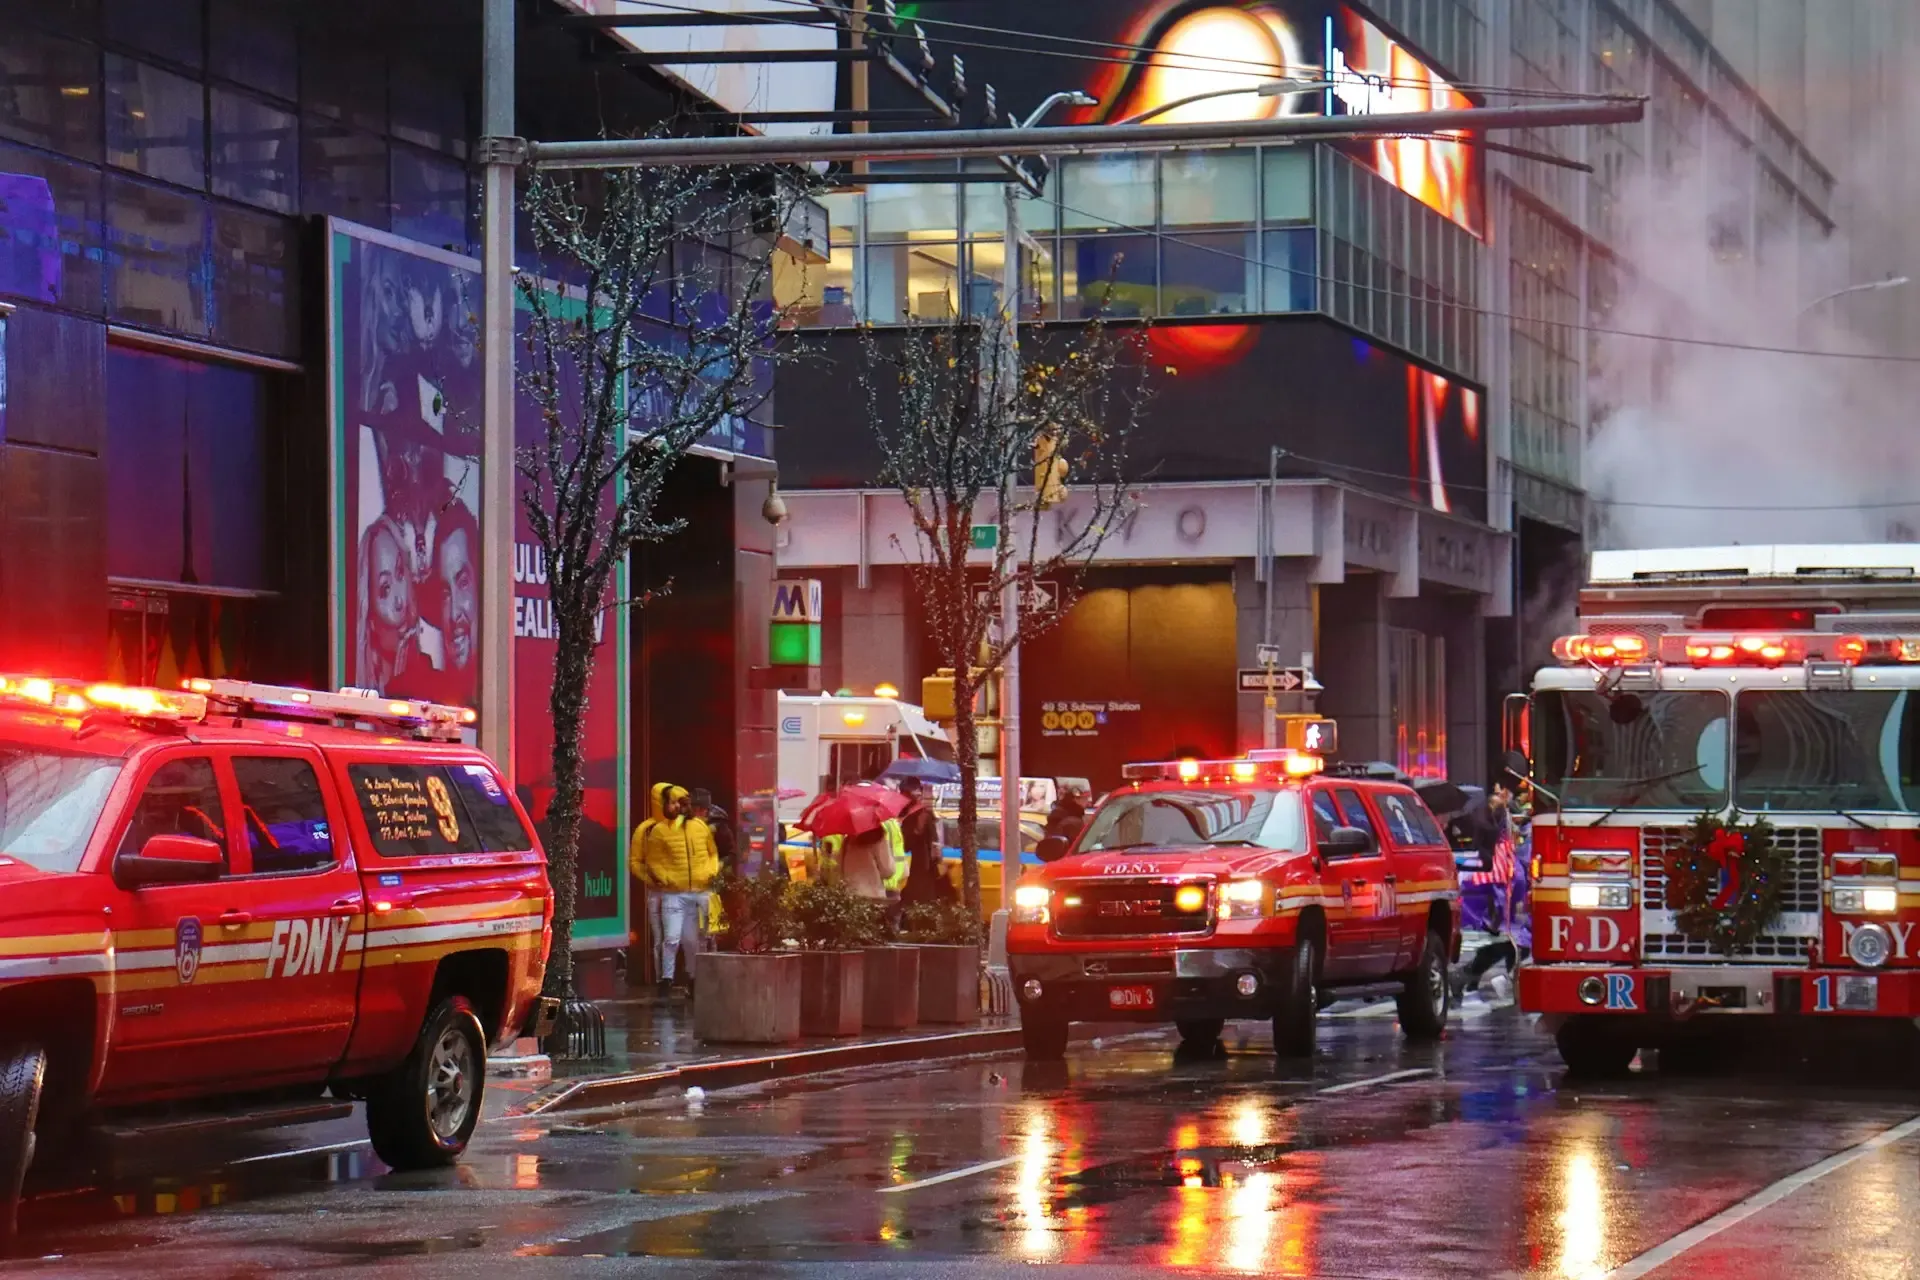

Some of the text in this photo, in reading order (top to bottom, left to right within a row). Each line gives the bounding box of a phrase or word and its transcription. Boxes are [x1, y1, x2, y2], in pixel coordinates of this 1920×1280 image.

[514, 543, 549, 585] ULU
[1042, 702, 1140, 712] 49 St Subway Station
[427, 776, 460, 843] 9
[584, 871, 612, 897] hulu
[264, 914, 351, 979] FDNY
[1549, 916, 1630, 952] F.D.
[1125, 989, 1154, 1005] Div 3
[1604, 973, 1834, 1012] R 1
